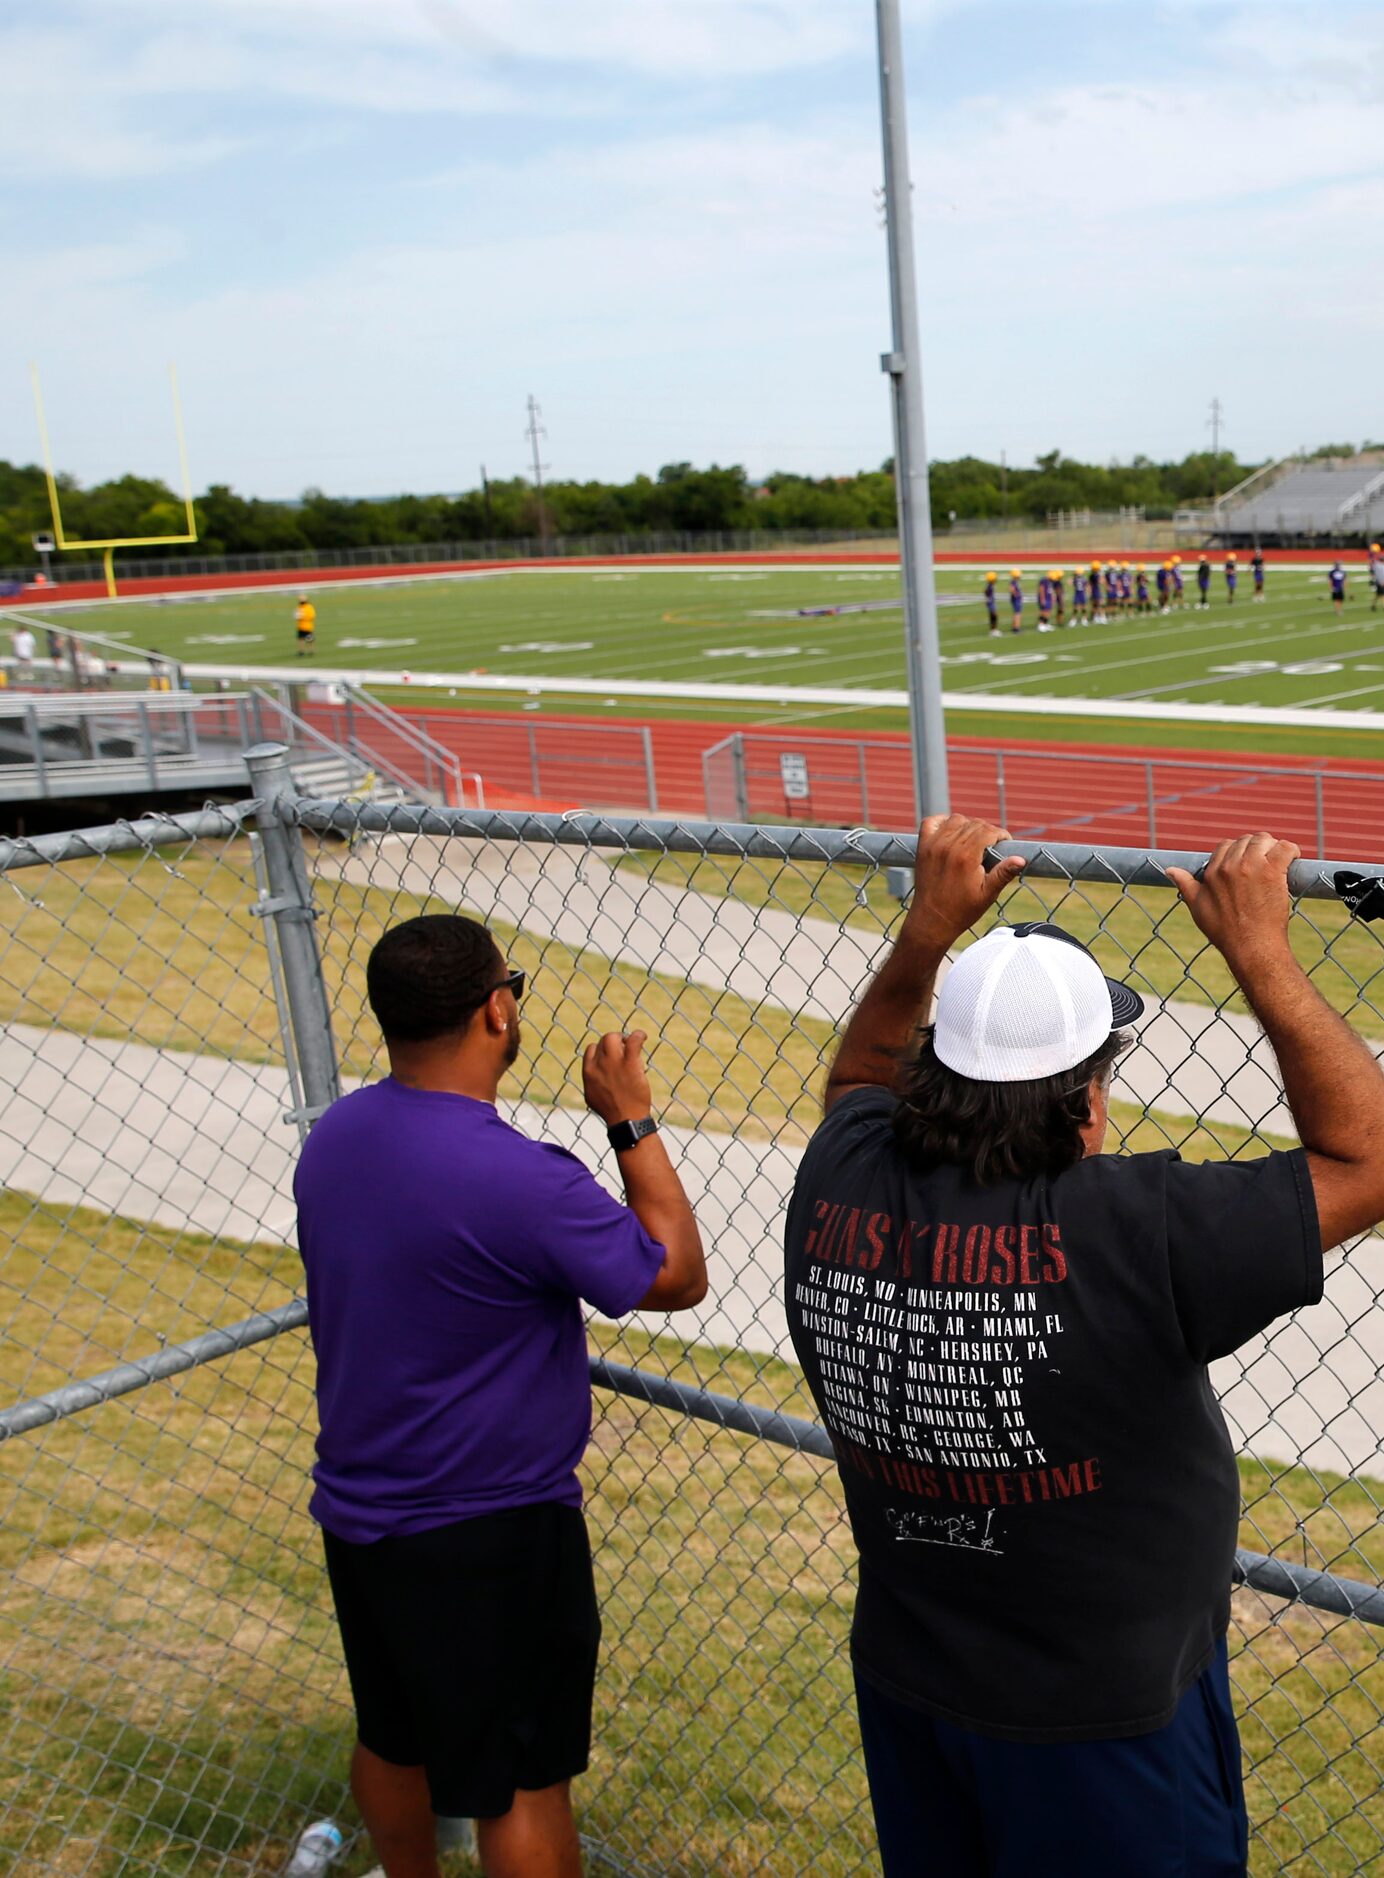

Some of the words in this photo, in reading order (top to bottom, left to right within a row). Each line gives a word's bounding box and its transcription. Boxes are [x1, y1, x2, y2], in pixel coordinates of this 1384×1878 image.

[931, 1222, 1068, 1285] ROSES
[795, 1283, 831, 1312] DENVER,
[834, 1296, 850, 1316] CO
[864, 1302, 905, 1329] LITTLE
[906, 1312, 940, 1336] ROCK,
[945, 1316, 965, 1336] AR
[983, 1317, 1040, 1337] MIAMI,
[1045, 1314, 1064, 1334] FL
[809, 1265, 823, 1286] ST.
[827, 1270, 869, 1297] LOUIS,
[874, 1280, 896, 1301] MO
[907, 1287, 1006, 1313] MINNEAPOLIS,
[1014, 1292, 1037, 1312] MN
[802, 1309, 902, 1354] WINSTON-SALEM,
[909, 1337, 924, 1357] NC
[940, 1340, 1020, 1362] HERSHEY,
[1027, 1340, 1048, 1360] PA
[816, 1336, 870, 1369] BUFFALO,
[877, 1352, 893, 1373] NY
[907, 1360, 995, 1387] MONTREAL,
[1003, 1366, 1024, 1387] QC
[820, 1359, 869, 1390] OTTAWA,
[873, 1375, 889, 1395] ON
[904, 1382, 987, 1409] WINNIPEG,
[995, 1389, 1022, 1408] MB
[823, 1379, 869, 1411] REGINA,
[873, 1396, 890, 1416] SK
[905, 1404, 994, 1430] EDMONTON,
[1003, 1411, 1026, 1428] AB
[824, 1396, 896, 1437] VANCOUVER,
[900, 1423, 917, 1442] BC
[933, 1430, 1002, 1449] GEORGE,
[1009, 1430, 1036, 1448] WA
[840, 1420, 871, 1448] PASO,
[874, 1435, 891, 1454] TX
[905, 1443, 933, 1463] SAN
[940, 1450, 1018, 1468] ANTONIO,
[1024, 1448, 1047, 1465] TX
[946, 1456, 1103, 1505] LIFETIME
